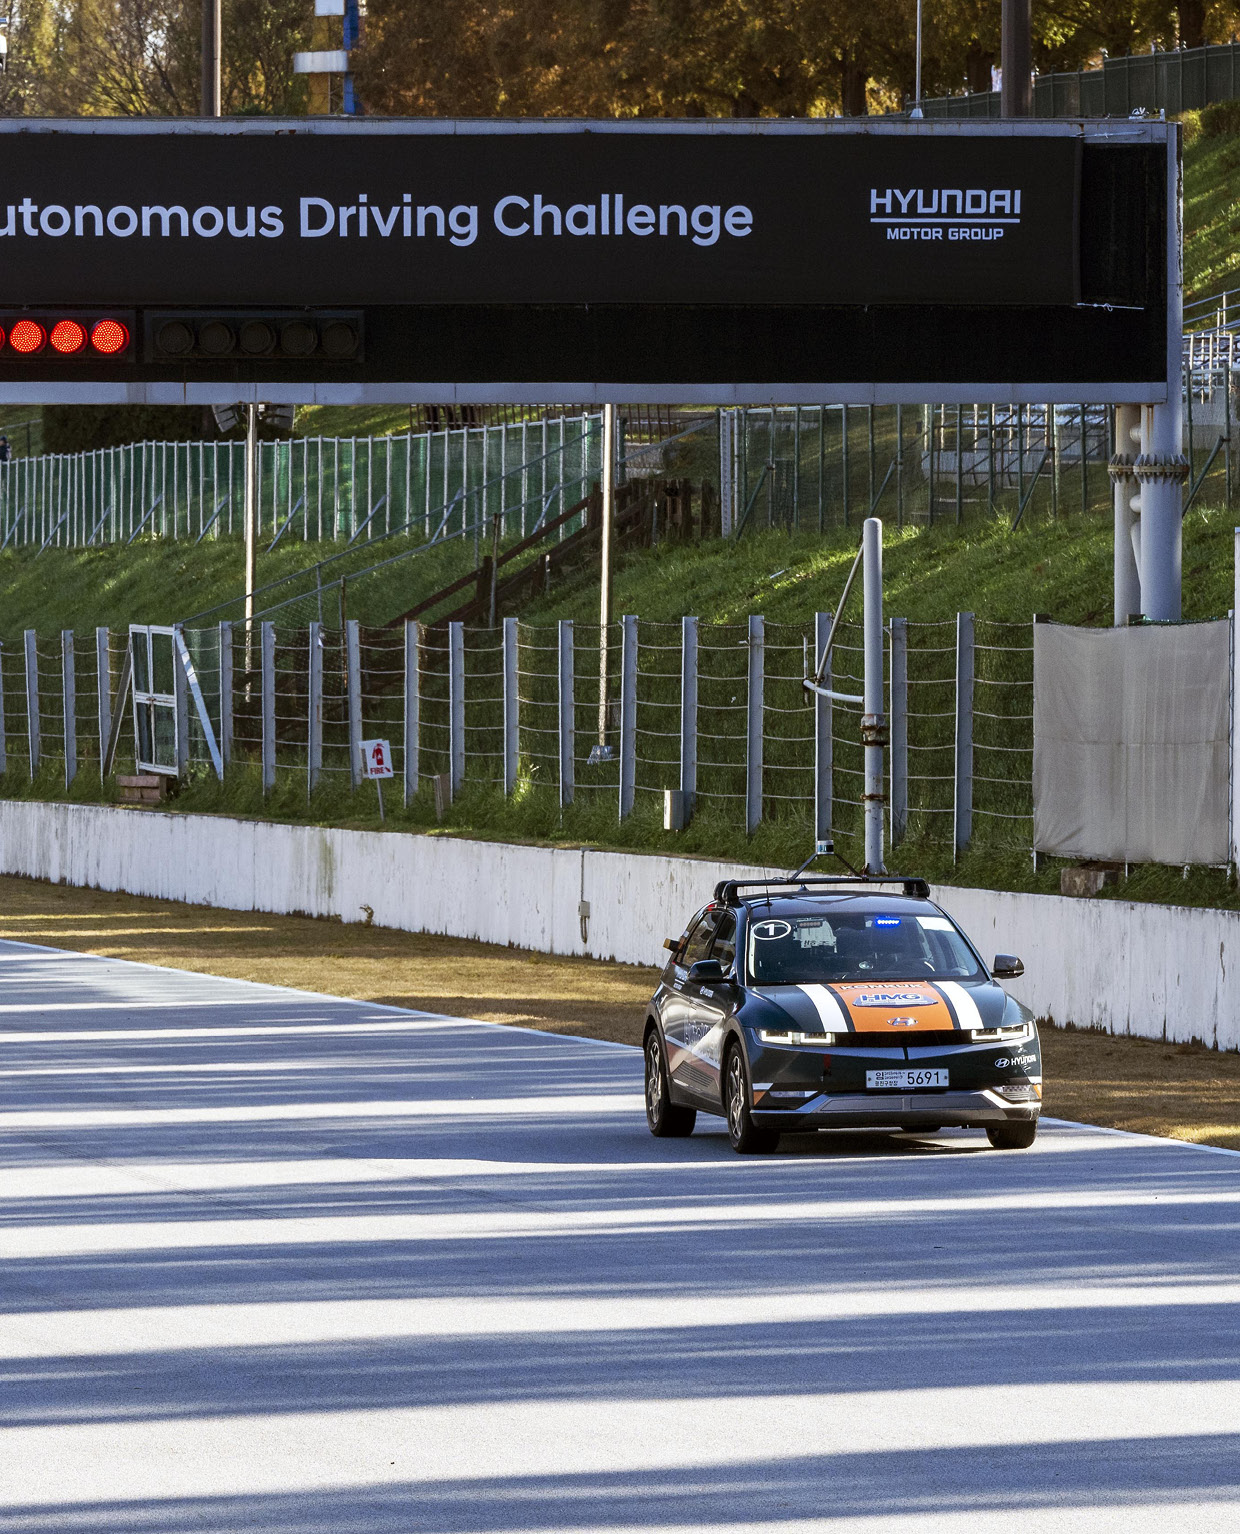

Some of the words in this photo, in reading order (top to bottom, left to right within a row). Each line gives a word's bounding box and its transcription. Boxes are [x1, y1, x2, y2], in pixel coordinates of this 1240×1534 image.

[870, 188, 1021, 214] HYUNDAI
[299, 193, 478, 247] Driving
[493, 193, 753, 247] Challenge
[886, 227, 943, 240] MOTOR
[948, 227, 1004, 241] GROUP
[370, 766, 385, 775] FIRE
[907, 1071, 940, 1085] 5691
